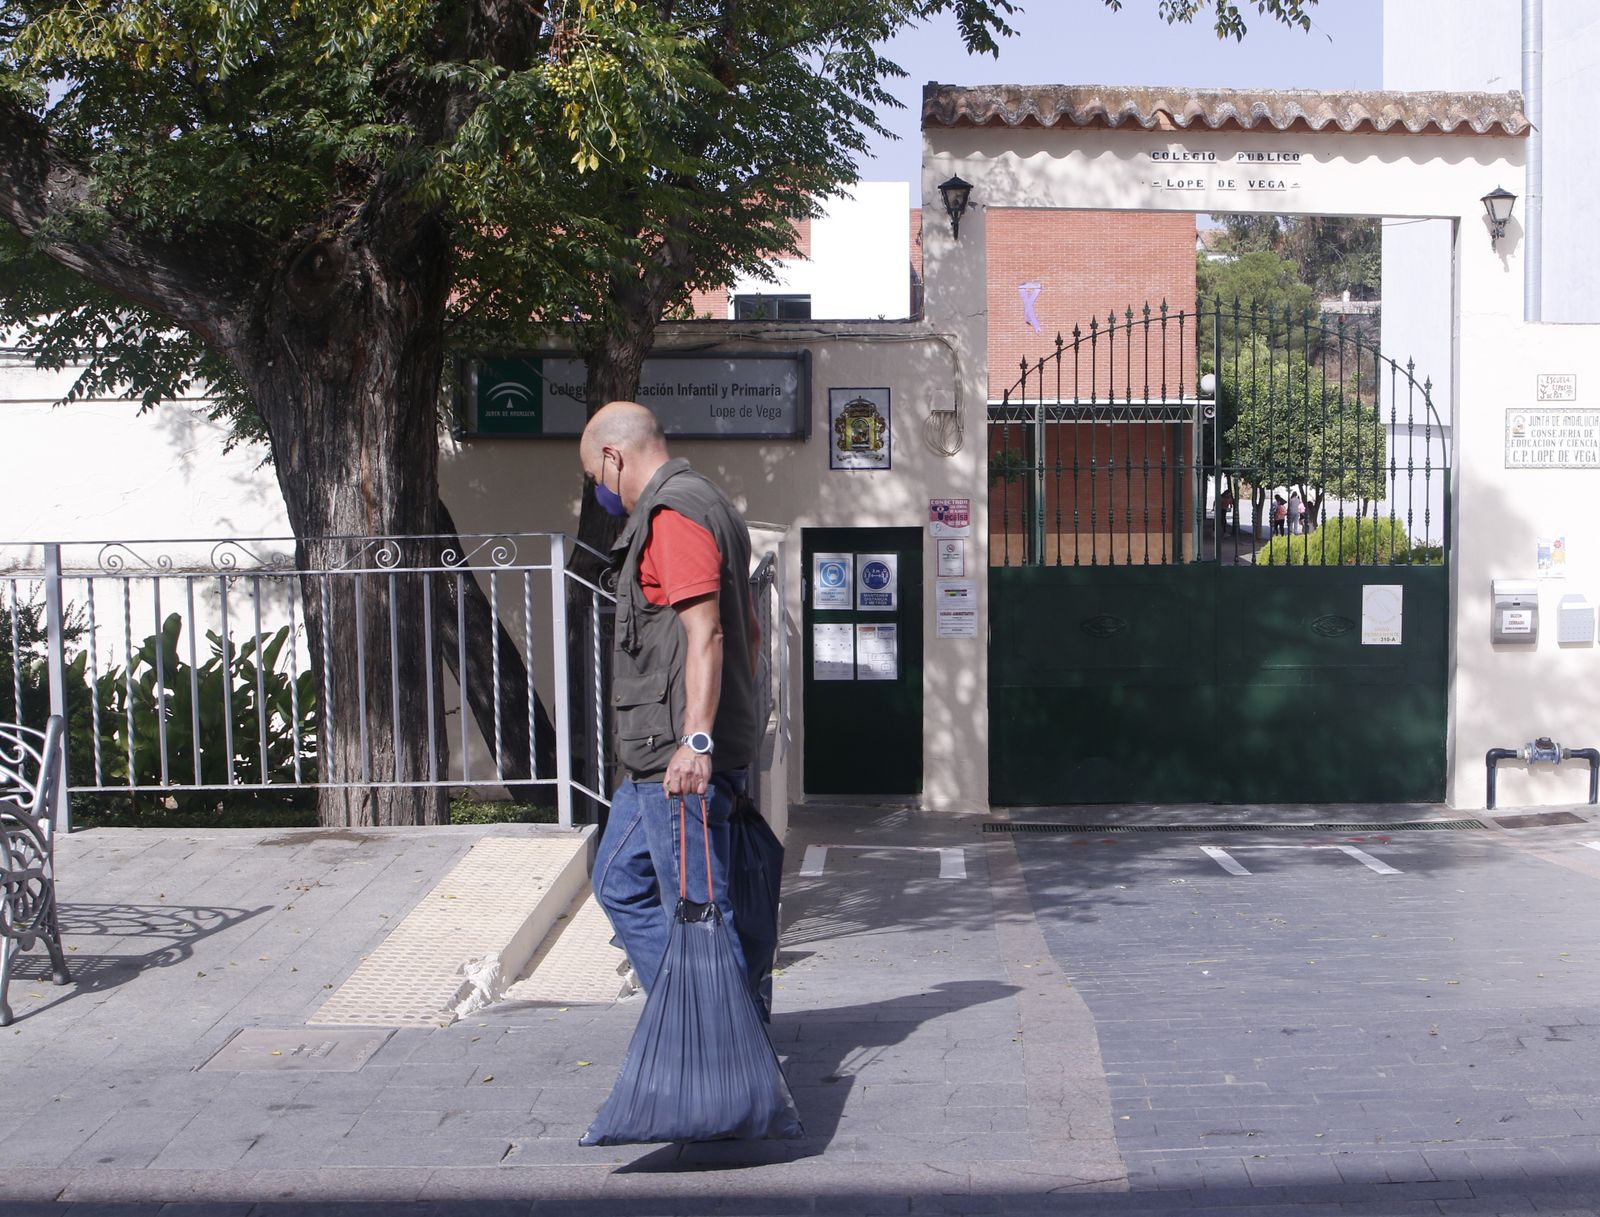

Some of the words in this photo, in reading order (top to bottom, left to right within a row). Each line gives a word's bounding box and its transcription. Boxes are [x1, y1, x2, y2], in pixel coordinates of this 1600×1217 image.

[1152, 152, 1216, 161] COLEGIO
[1238, 152, 1300, 161] PUBLICO
[1167, 179, 1204, 188] LOPE
[1218, 179, 1235, 188] DE
[1248, 180, 1285, 188] VEGA
[550, 383, 587, 398] Colegi
[677, 383, 718, 396] Infantil
[721, 386, 728, 399] y
[731, 383, 781, 396] Primaria
[710, 404, 735, 420] Lope
[739, 404, 752, 417] de
[756, 404, 782, 420] Vega
[1528, 416, 1550, 427] JUNTA
[1552, 416, 1561, 427] DE
[1584, 429, 1594, 438] DE
[1559, 439, 1564, 448] Y
[1566, 439, 1598, 448] CIENCIA
[1531, 450, 1555, 463] LOPE
[1558, 450, 1570, 463] DE
[1574, 450, 1597, 463] VEGA
